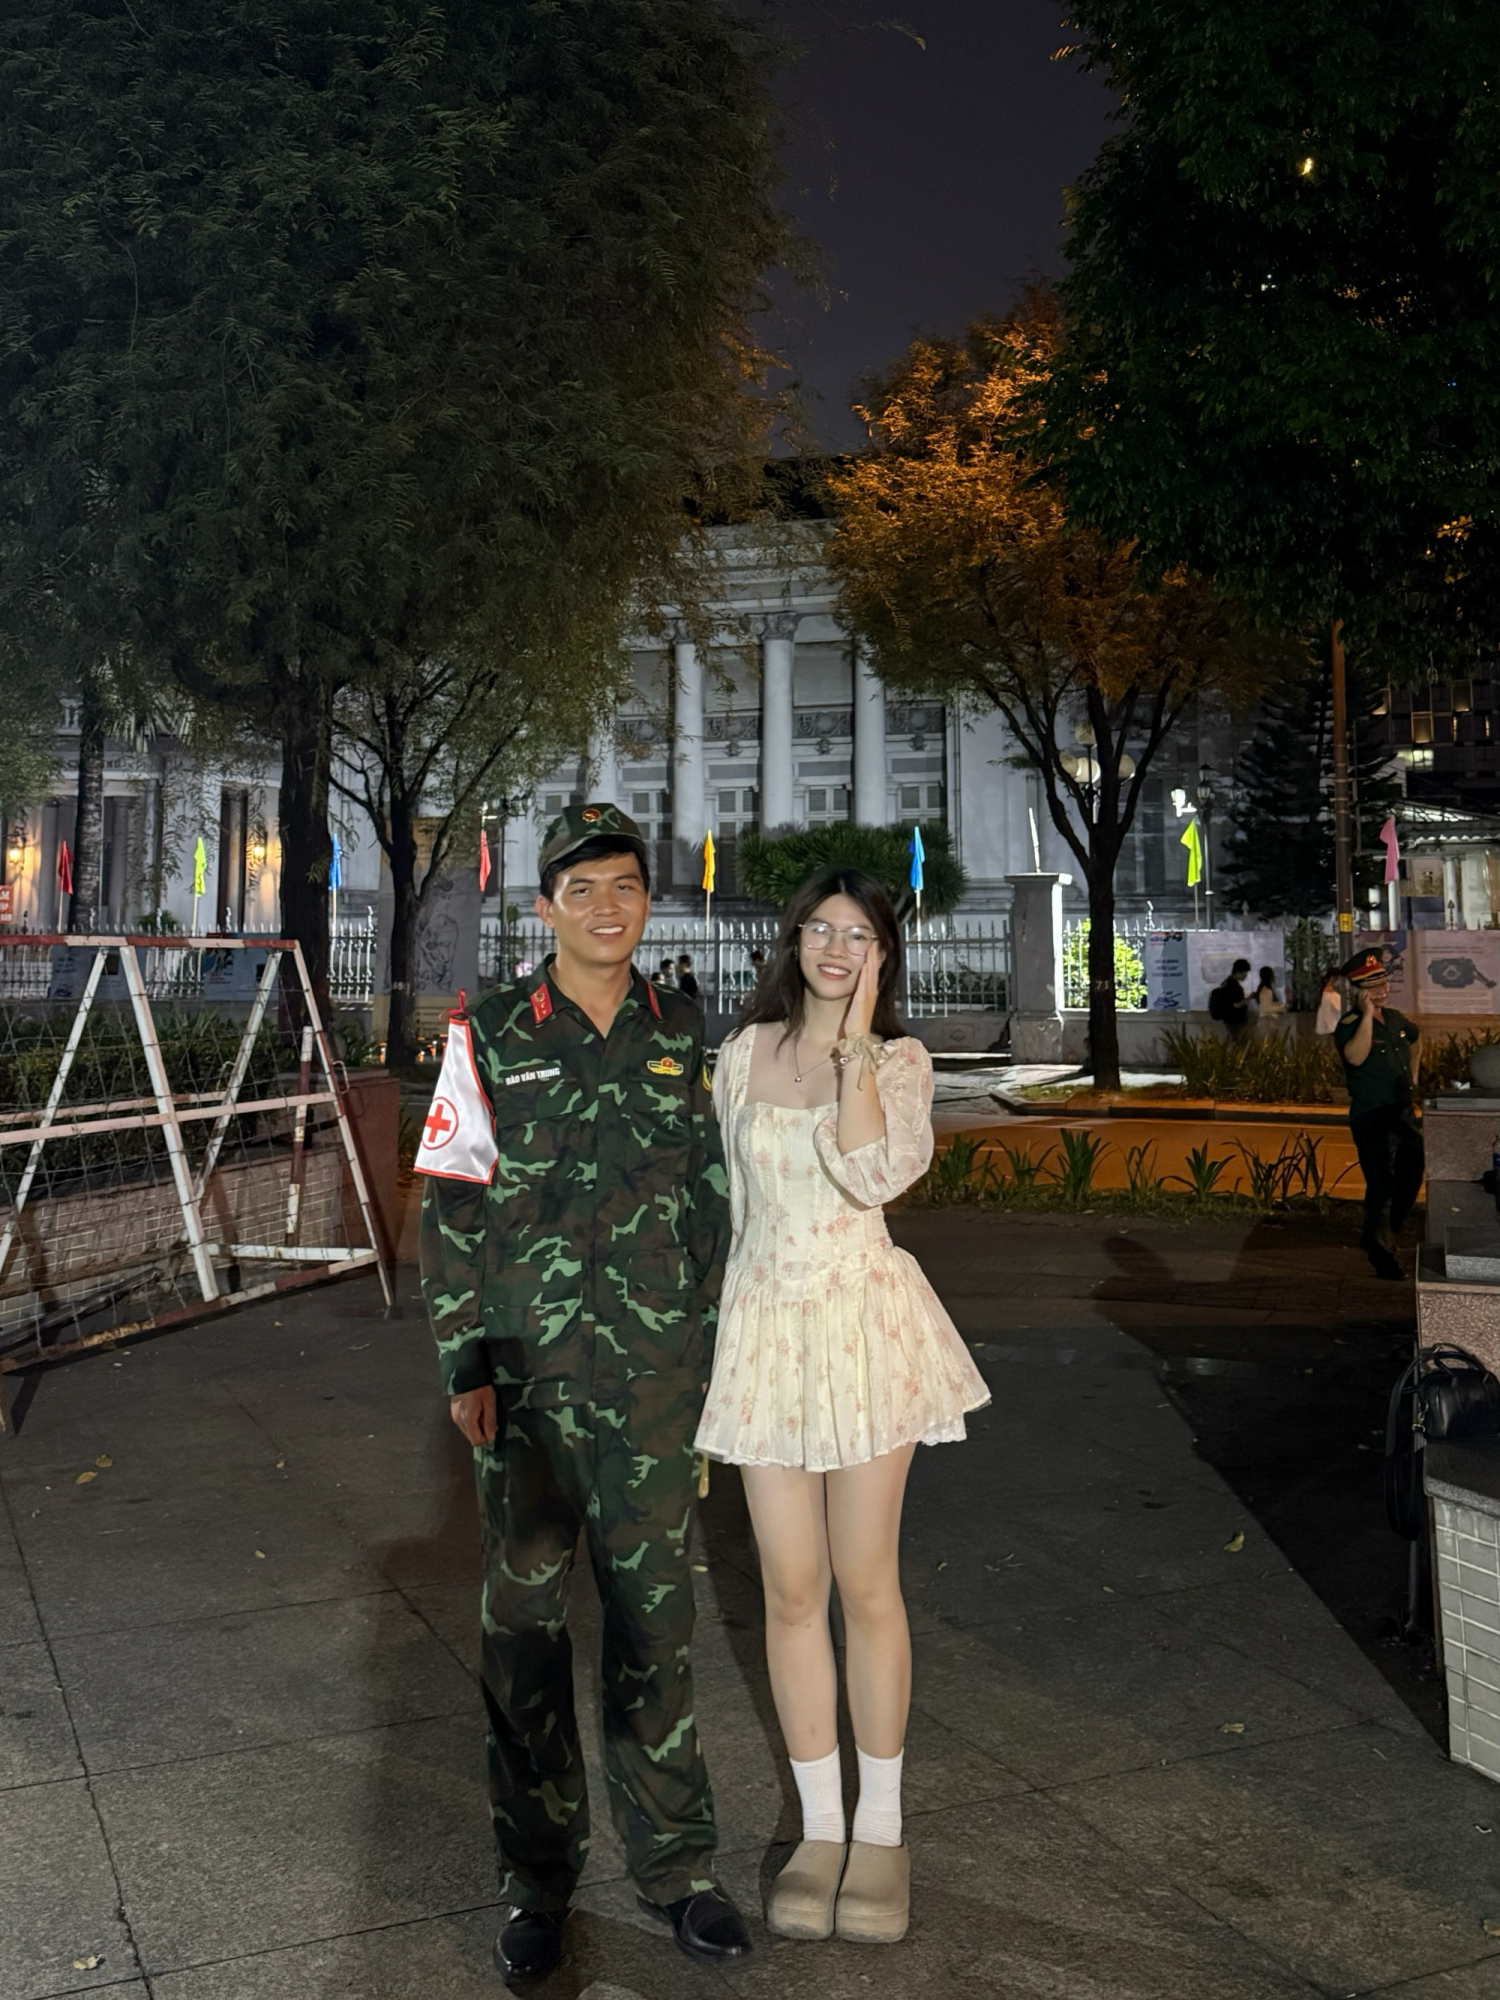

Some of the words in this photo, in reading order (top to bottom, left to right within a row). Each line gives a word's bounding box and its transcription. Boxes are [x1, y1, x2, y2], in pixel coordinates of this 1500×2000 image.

[1095, 980, 1109, 990] 71
[520, 1071, 536, 1082] VĂN
[536, 1067, 561, 1079] TRUNG
